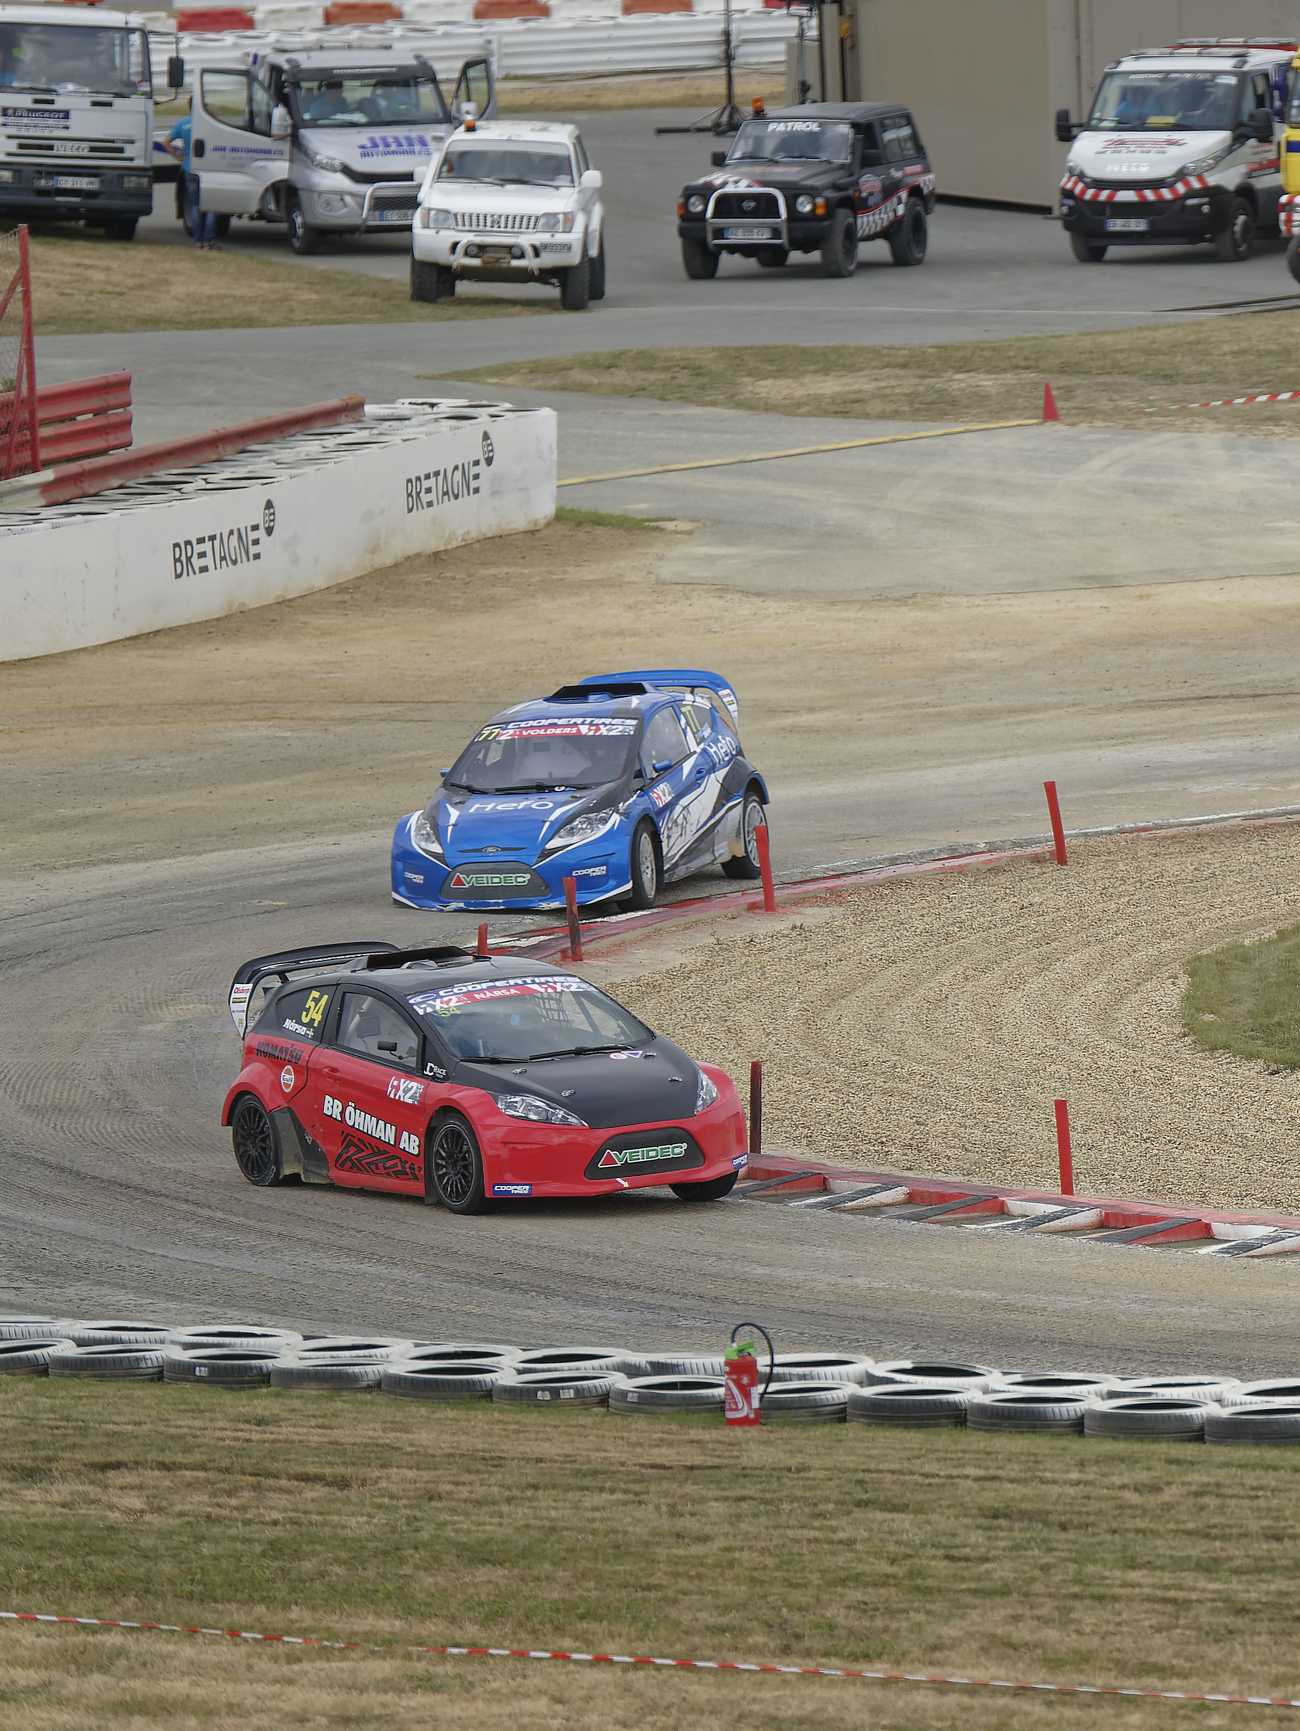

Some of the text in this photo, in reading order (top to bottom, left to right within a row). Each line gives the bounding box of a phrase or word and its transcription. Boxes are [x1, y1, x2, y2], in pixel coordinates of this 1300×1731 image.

[767, 121, 821, 132] PATROL
[405, 458, 480, 514] BRETAGNE
[172, 523, 262, 580] BRETAGNE
[522, 727, 578, 736] VOLDERS
[463, 873, 528, 886] VEIDEC
[572, 866, 607, 877] COOPER
[474, 987, 521, 1001] NÅRSA
[301, 990, 329, 1027] 54
[323, 1094, 420, 1155] BR ÖHMAN AB
[613, 1144, 684, 1165] VEIDEC
